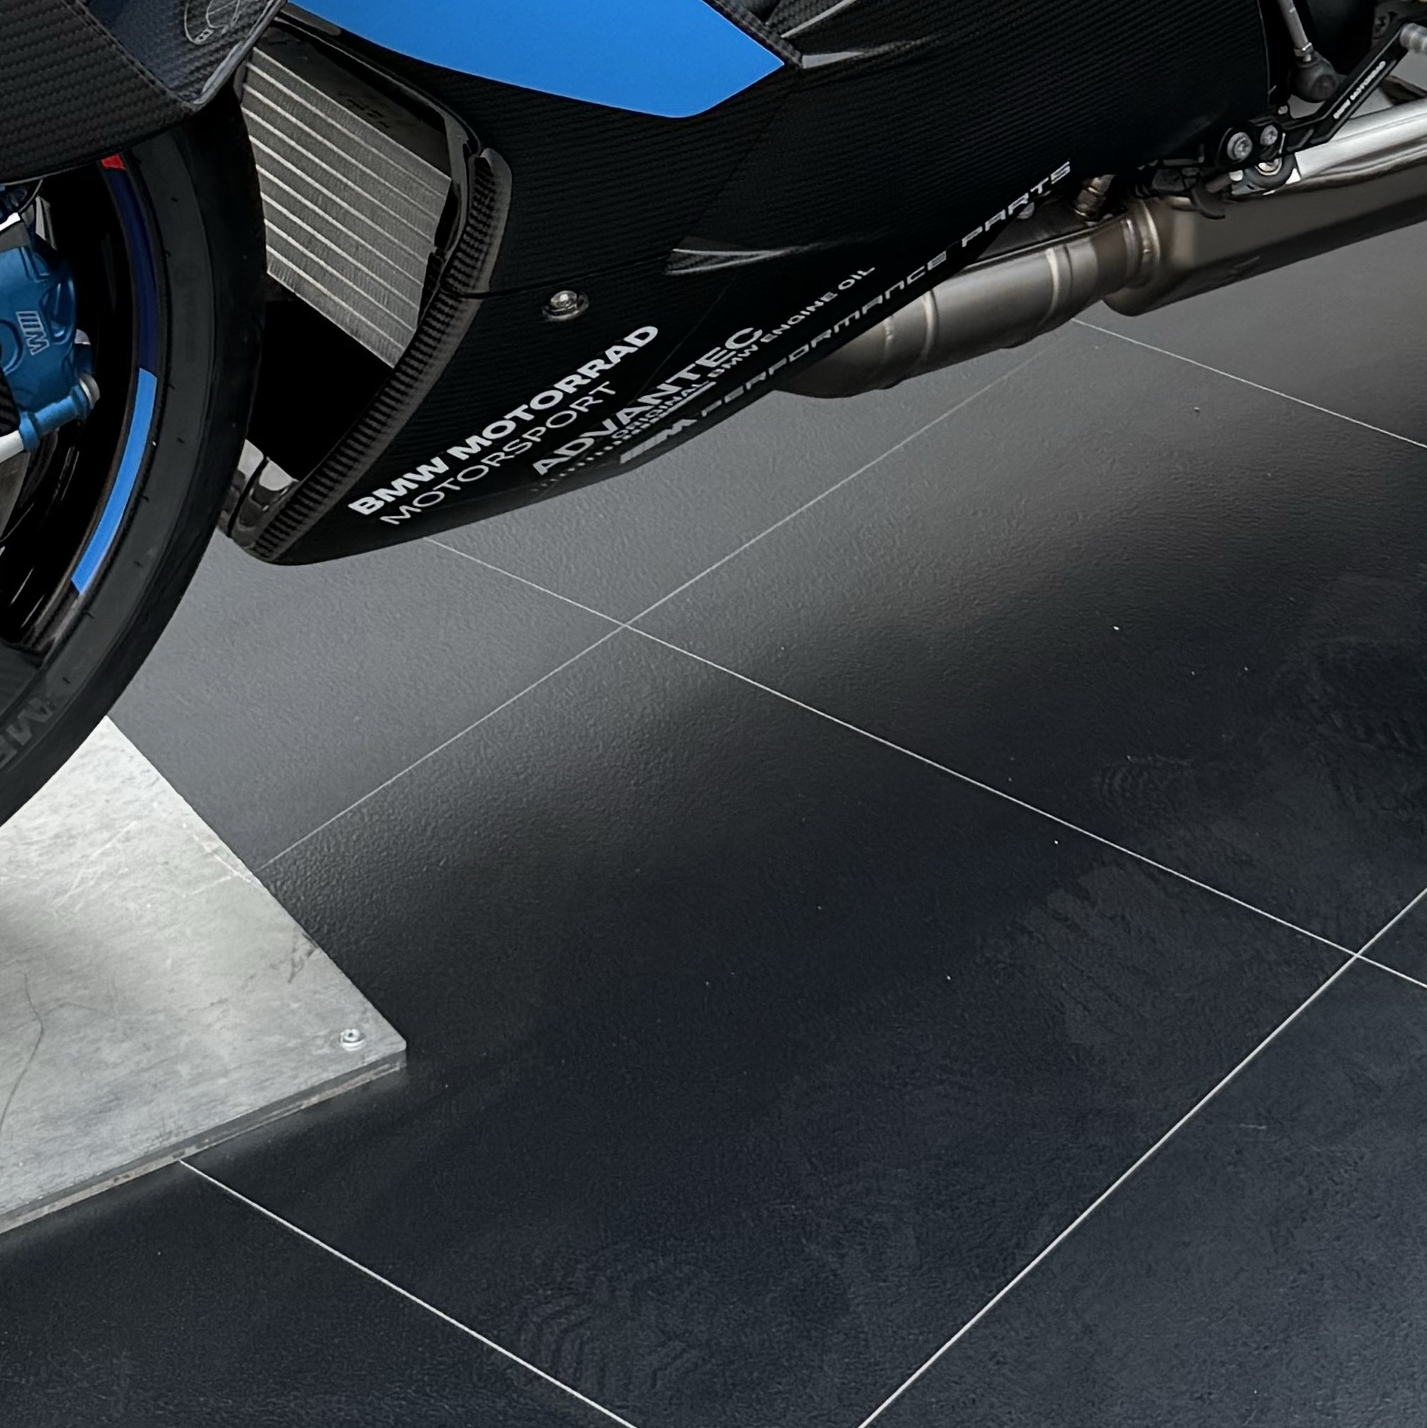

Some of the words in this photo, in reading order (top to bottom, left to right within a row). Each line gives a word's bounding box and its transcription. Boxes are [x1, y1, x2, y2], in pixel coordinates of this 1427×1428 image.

[611, 380, 710, 439] ORIGINAL
[707, 343, 759, 378] BMW
[760, 291, 839, 344] ENGINE
[838, 266, 876, 291] OIL
[701, 250, 948, 417] PERFORMANCE
[961, 160, 1072, 247] PARTS
[347, 456, 449, 515] BMW
[447, 325, 659, 460] MOTORRAD
[380, 381, 616, 525] MOTORSPORT
[532, 327, 763, 476] ADVANTEC
